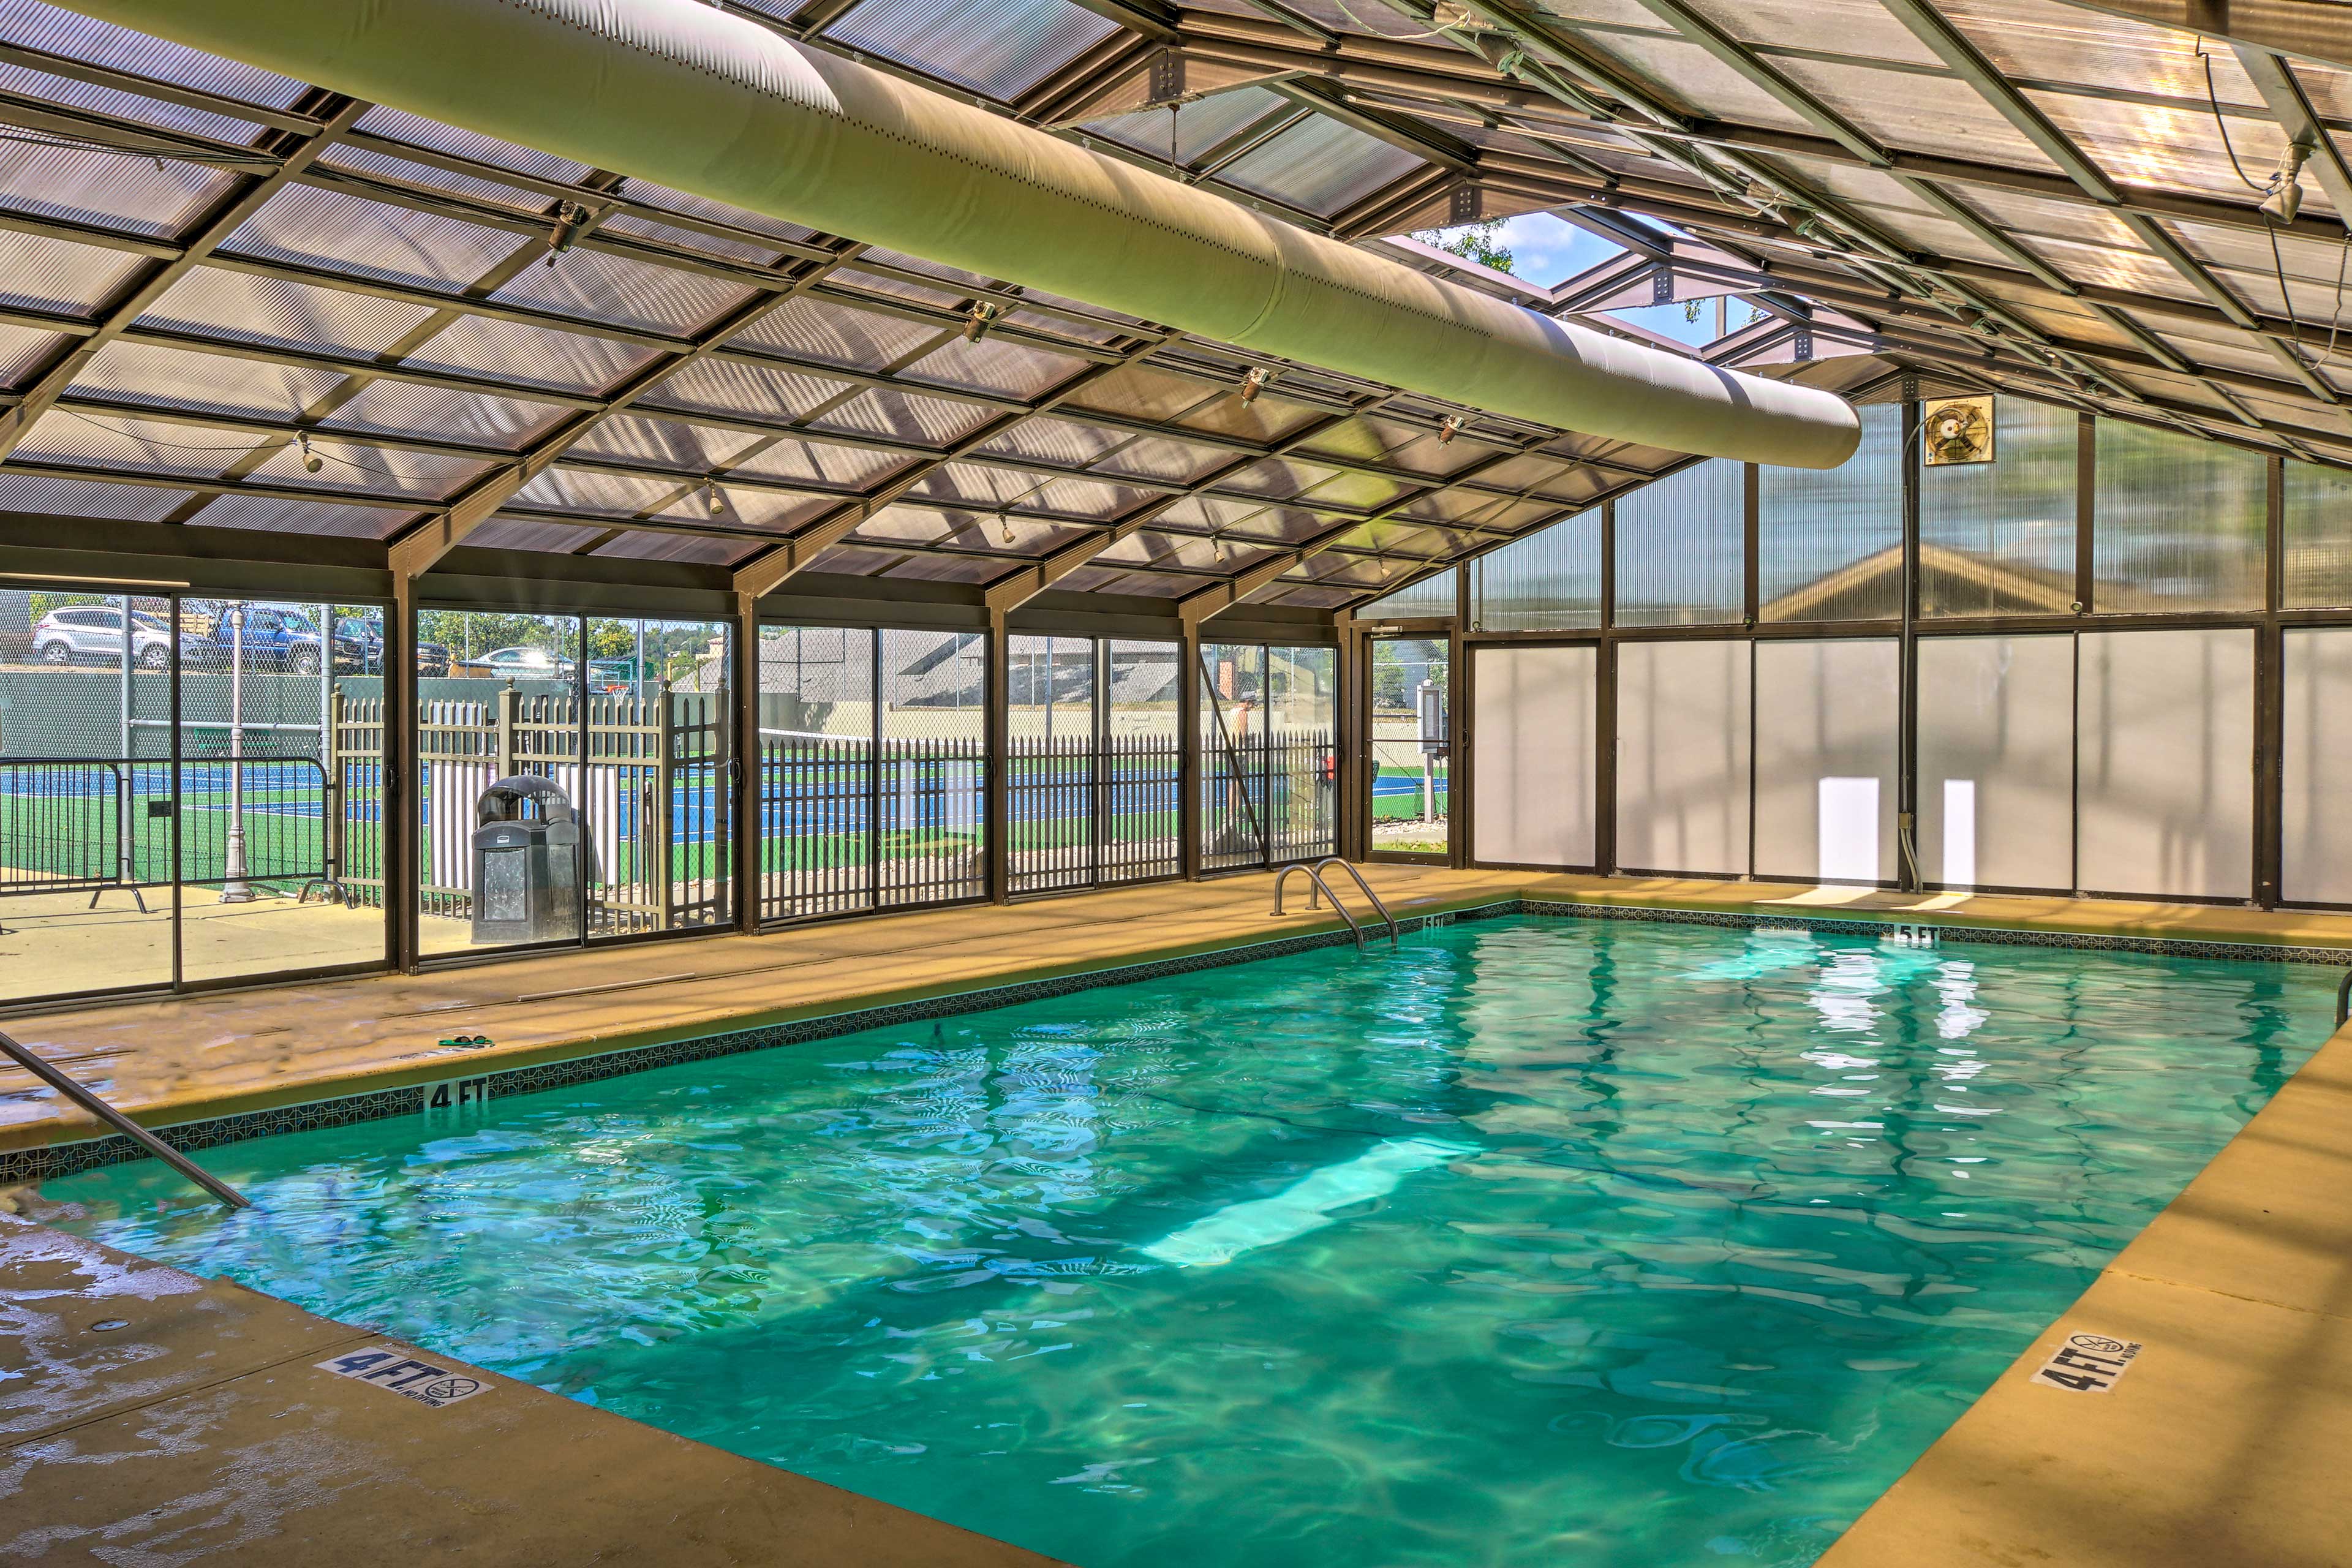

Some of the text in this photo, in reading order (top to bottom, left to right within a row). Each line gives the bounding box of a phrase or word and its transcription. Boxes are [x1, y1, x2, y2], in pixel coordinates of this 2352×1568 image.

[1900, 925, 1938, 941] 5 FT
[431, 1077, 486, 1107] 4 FT
[334, 1352, 394, 1373] 4
[2041, 1369, 2108, 1390] 4
[412, 1393, 445, 1407] DIVING
